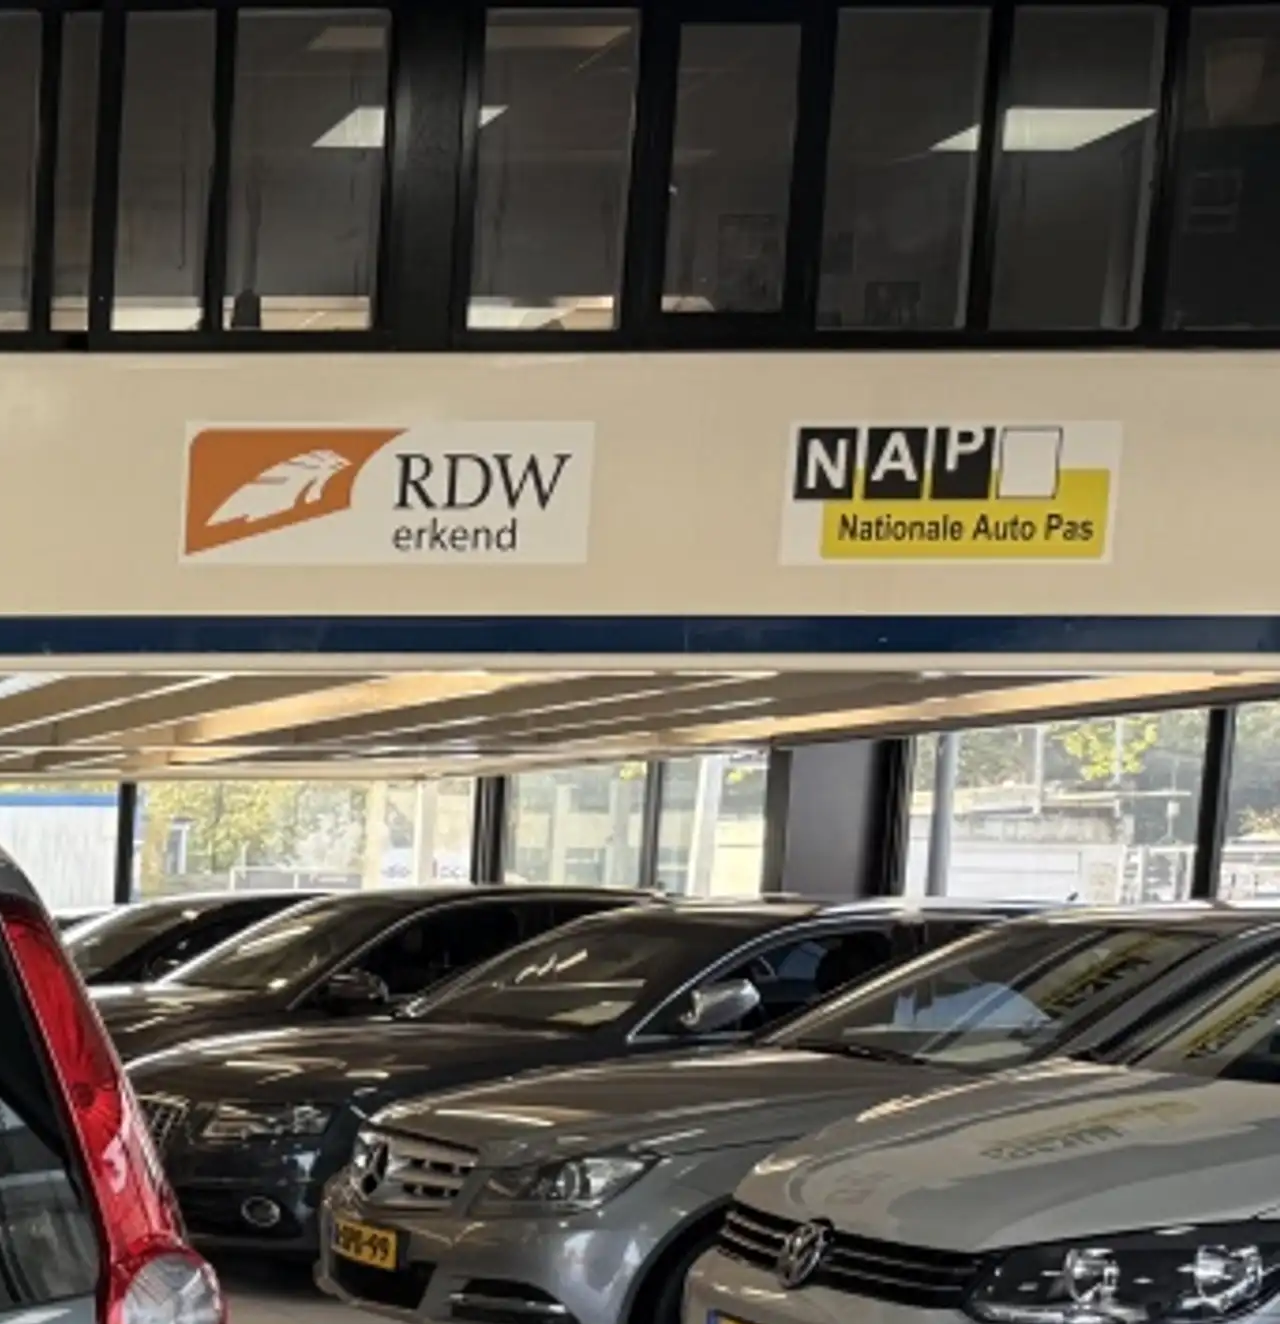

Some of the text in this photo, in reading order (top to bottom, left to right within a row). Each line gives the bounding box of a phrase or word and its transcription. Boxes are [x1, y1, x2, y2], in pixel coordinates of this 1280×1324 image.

[804, 427, 987, 490] NAP
[393, 453, 573, 511] RDW
[392, 517, 518, 552] erkend
[838, 512, 1095, 542] Nationale Auto Pas
